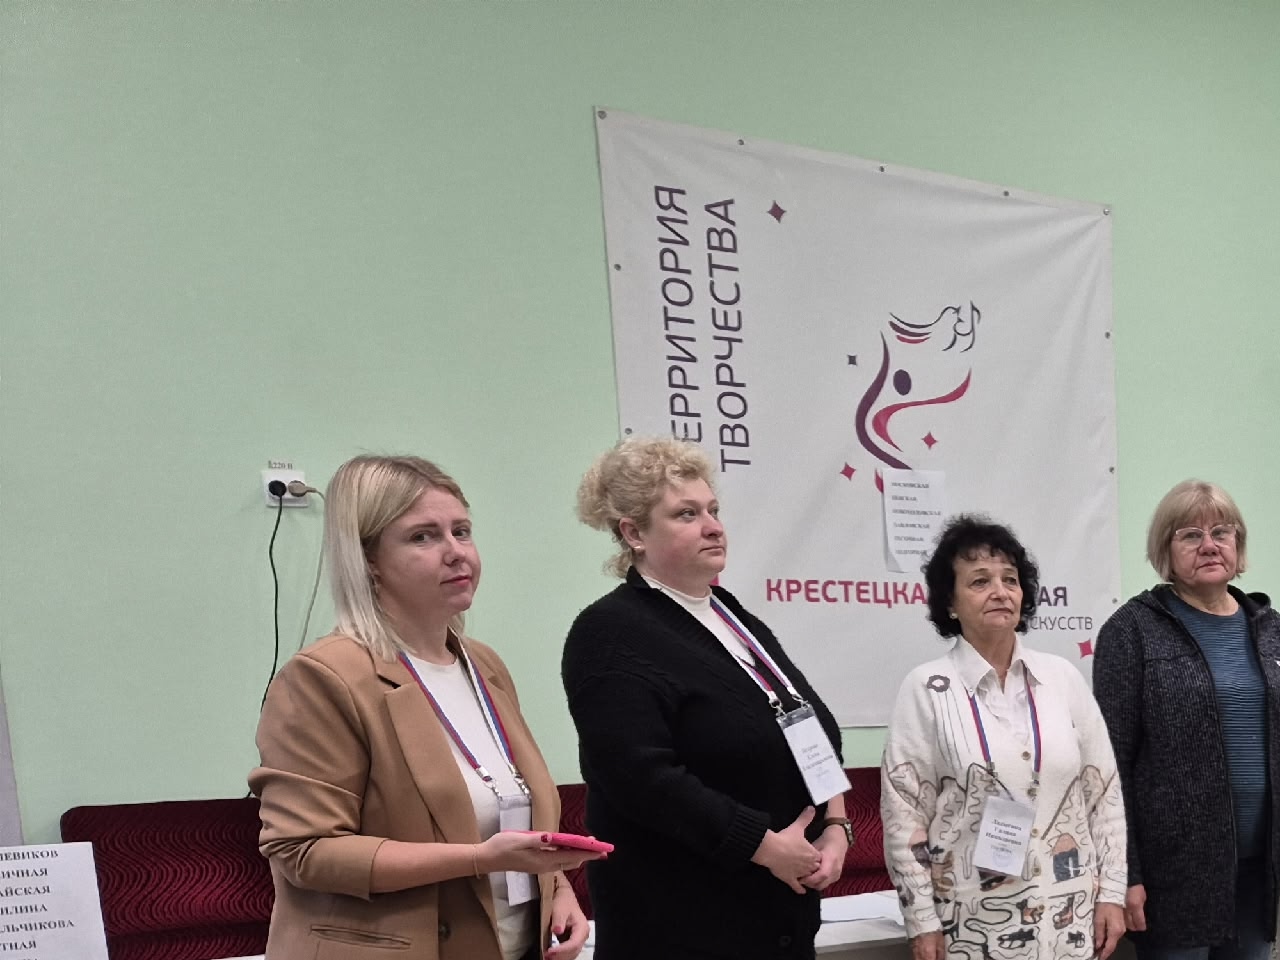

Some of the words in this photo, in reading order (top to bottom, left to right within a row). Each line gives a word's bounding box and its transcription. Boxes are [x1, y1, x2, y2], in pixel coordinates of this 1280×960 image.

[654, 185, 702, 443] ЕРРИТОРИЯ
[704, 198, 751, 472] ТВОРЧЕСТВА
[766, 578, 928, 608] КРЕСТЕЦКА
[1036, 586, 1068, 607] АЯ
[1029, 615, 1093, 631] СКУССТВ
